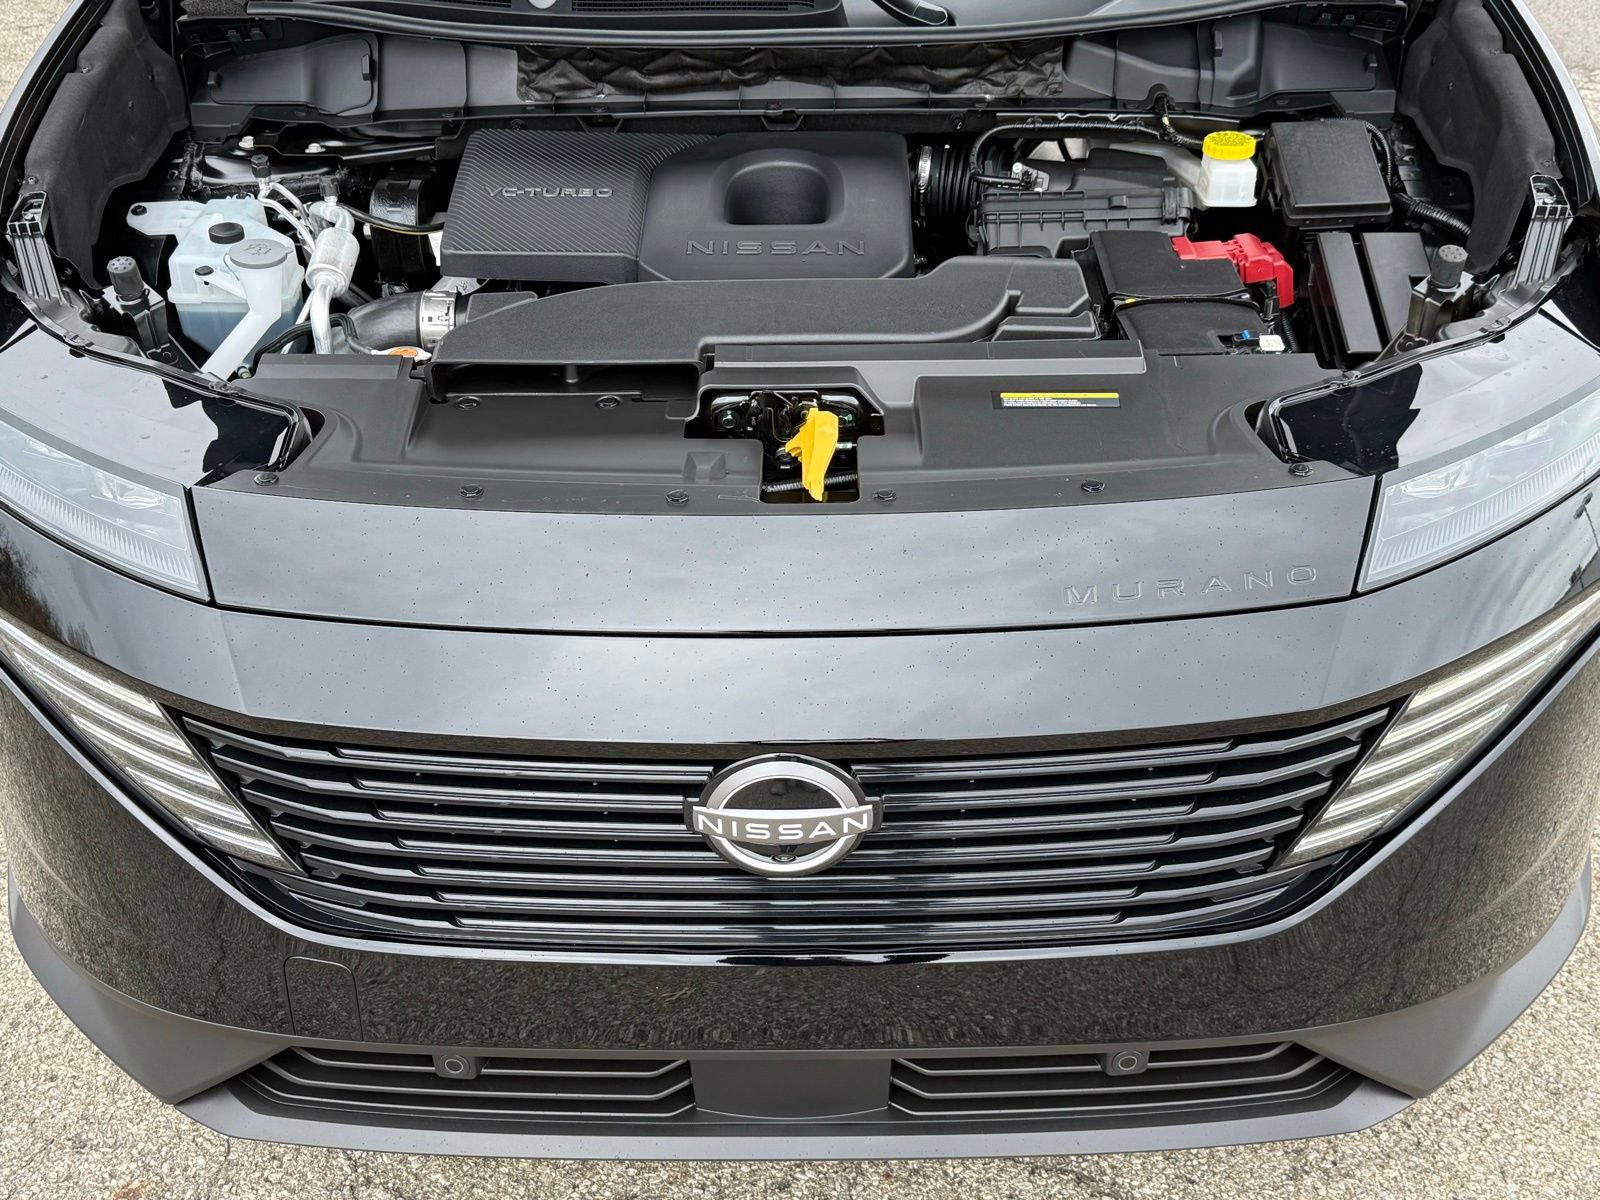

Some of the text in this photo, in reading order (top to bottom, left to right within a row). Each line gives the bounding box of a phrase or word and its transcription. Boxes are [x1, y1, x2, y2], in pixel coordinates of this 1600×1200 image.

[484, 187, 613, 198] VC-TURBO
[687, 240, 865, 256] NISSAN
[1064, 565, 1317, 606] MURANO
[697, 812, 869, 840] NISSAN
